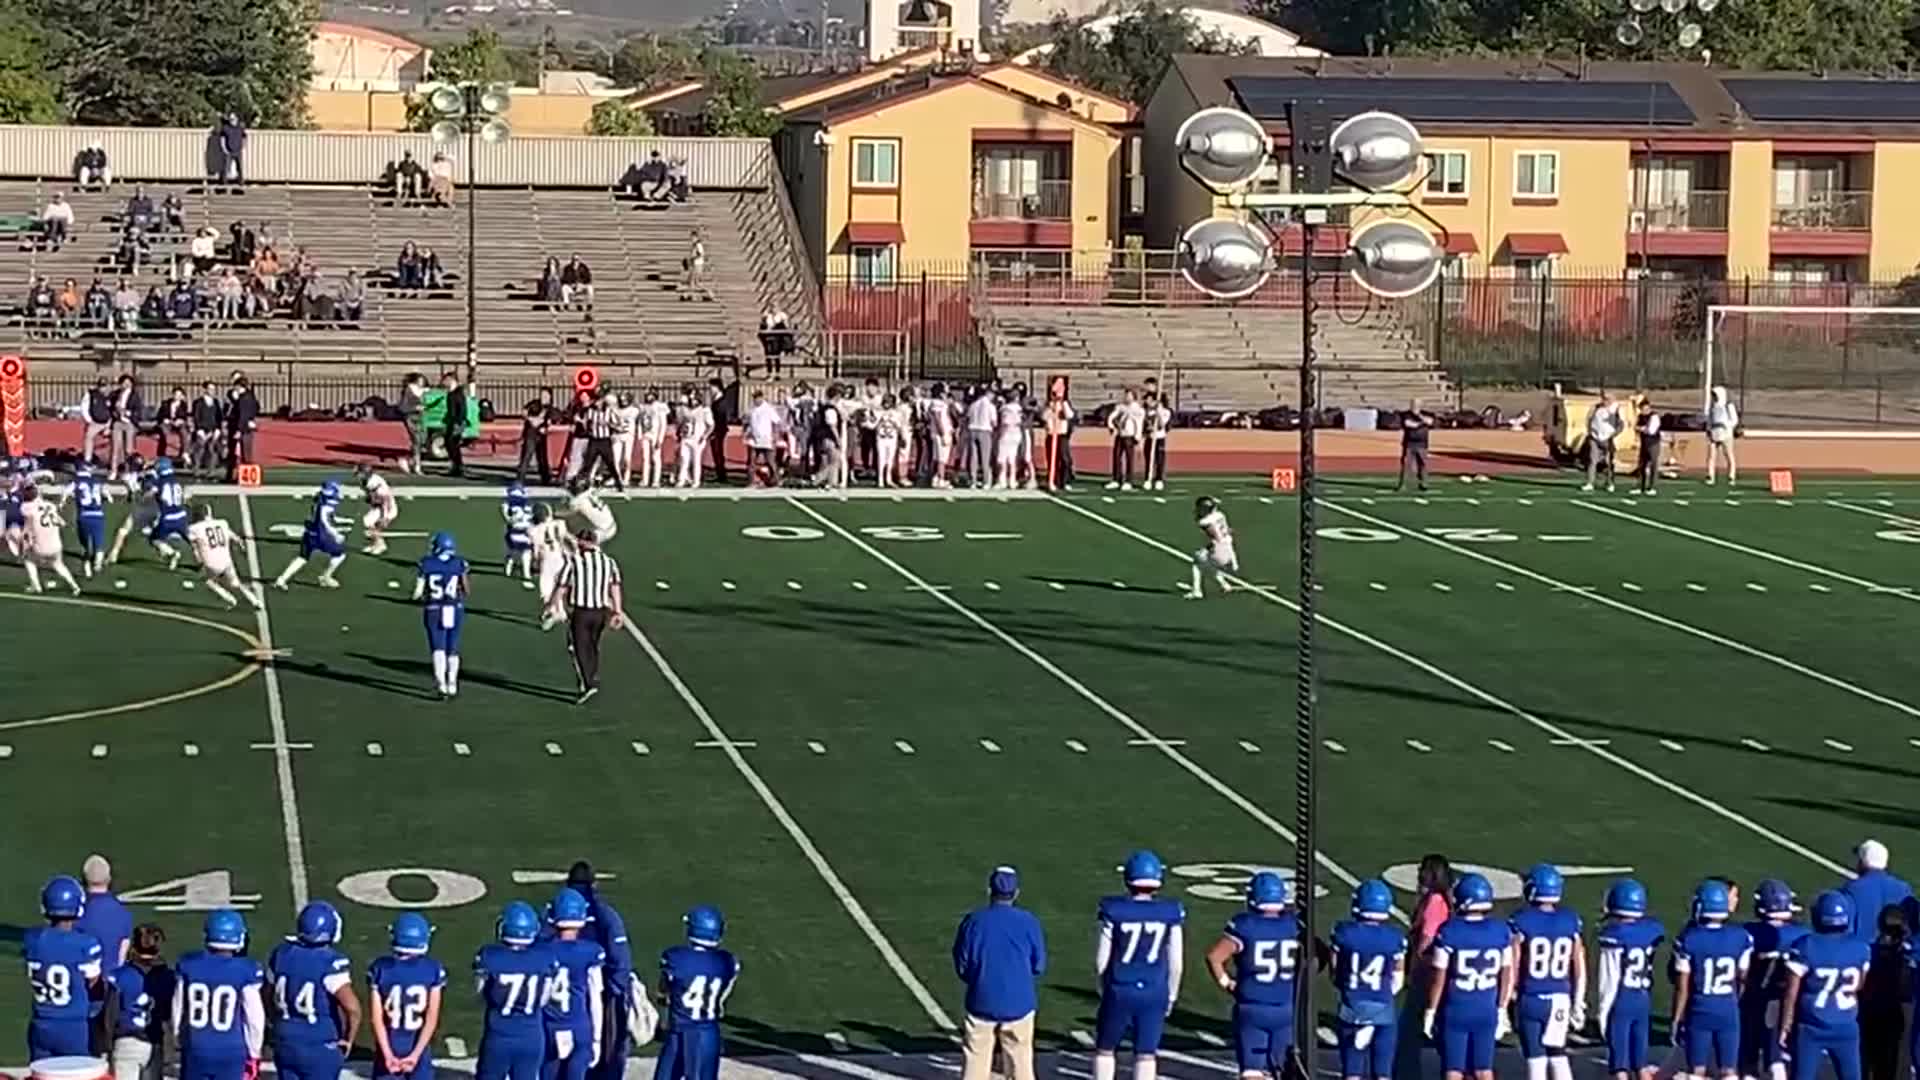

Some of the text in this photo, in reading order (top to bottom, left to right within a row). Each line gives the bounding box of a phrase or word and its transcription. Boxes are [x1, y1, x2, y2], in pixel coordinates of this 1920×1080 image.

[77, 483, 103, 505] 34
[241, 468, 258, 484] 40
[205, 525, 225, 549] 80
[429, 574, 459, 600] 54
[1120, 922, 1166, 964] 77
[1254, 940, 1299, 983] 55
[1529, 937, 1573, 979] 88
[28, 961, 72, 1006] 58
[1349, 952, 1385, 991] 14
[1457, 949, 1501, 991] 52
[1703, 956, 1736, 995] 12
[1814, 966, 1860, 1010] 72
[188, 983, 237, 1032] 80
[275, 975, 317, 1024] 44
[384, 984, 428, 1030] 42
[499, 973, 540, 1016] 71
[681, 975, 722, 1020] 41
